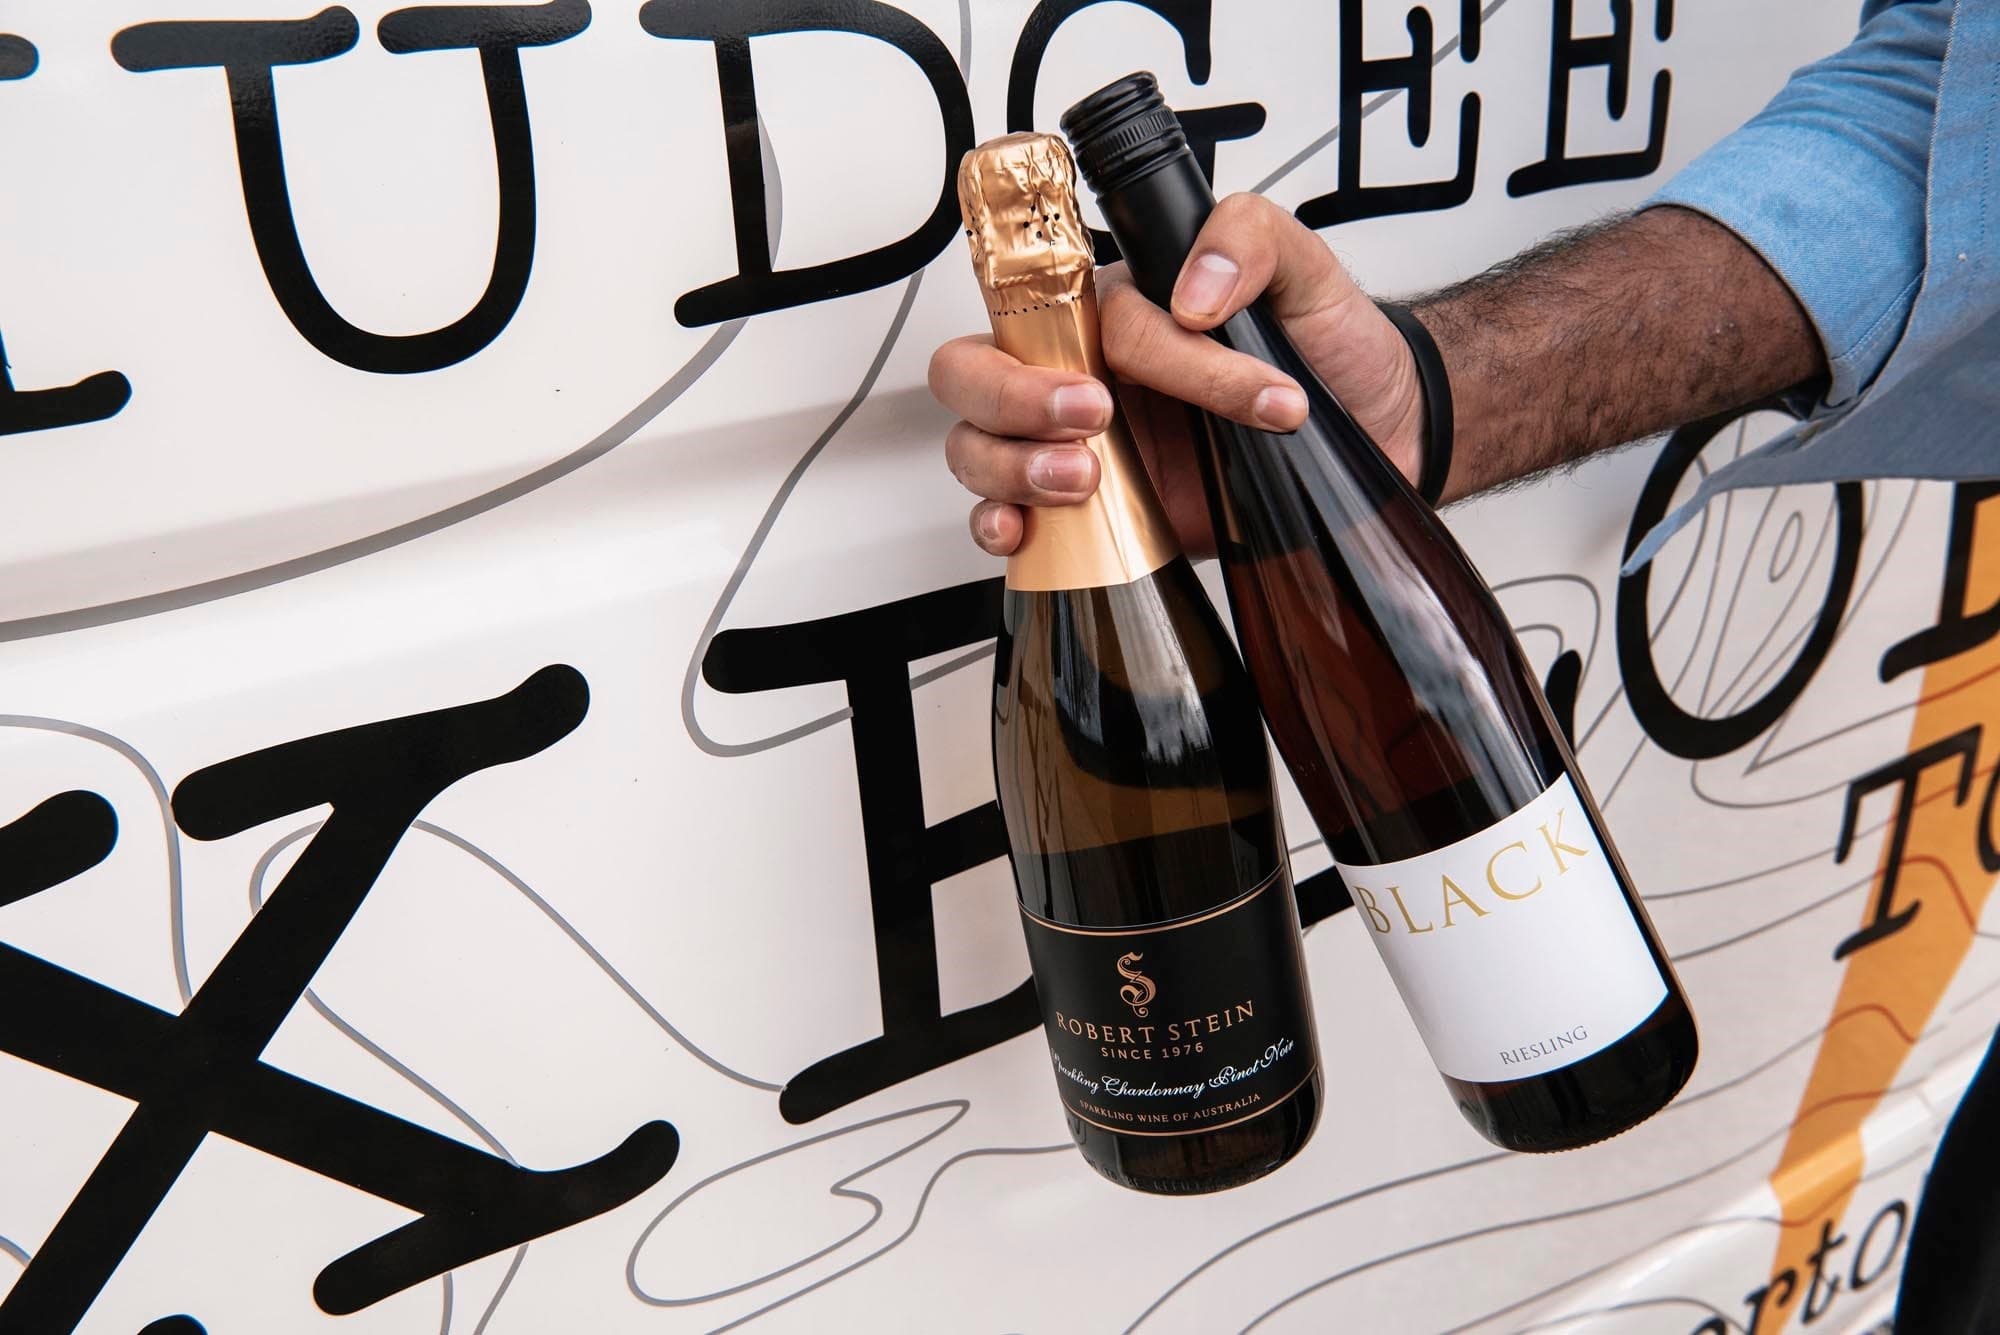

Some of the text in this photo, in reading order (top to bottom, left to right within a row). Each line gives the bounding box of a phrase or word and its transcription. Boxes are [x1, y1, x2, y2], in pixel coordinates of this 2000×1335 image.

[1352, 807, 1589, 934] BLACK
[1055, 1000, 1255, 1044] ROBERT STEIN
[1101, 1042, 1205, 1060] SINCE 1976
[1500, 1025, 1589, 1065] RIESLING
[1102, 1075, 1205, 1099] Chardonnay
[1208, 1060, 1260, 1089] Pinot
[1260, 1037, 1295, 1068] Noir
[1080, 1093, 1261, 1123] SPARKLING WINE OF AUSTRALIA
